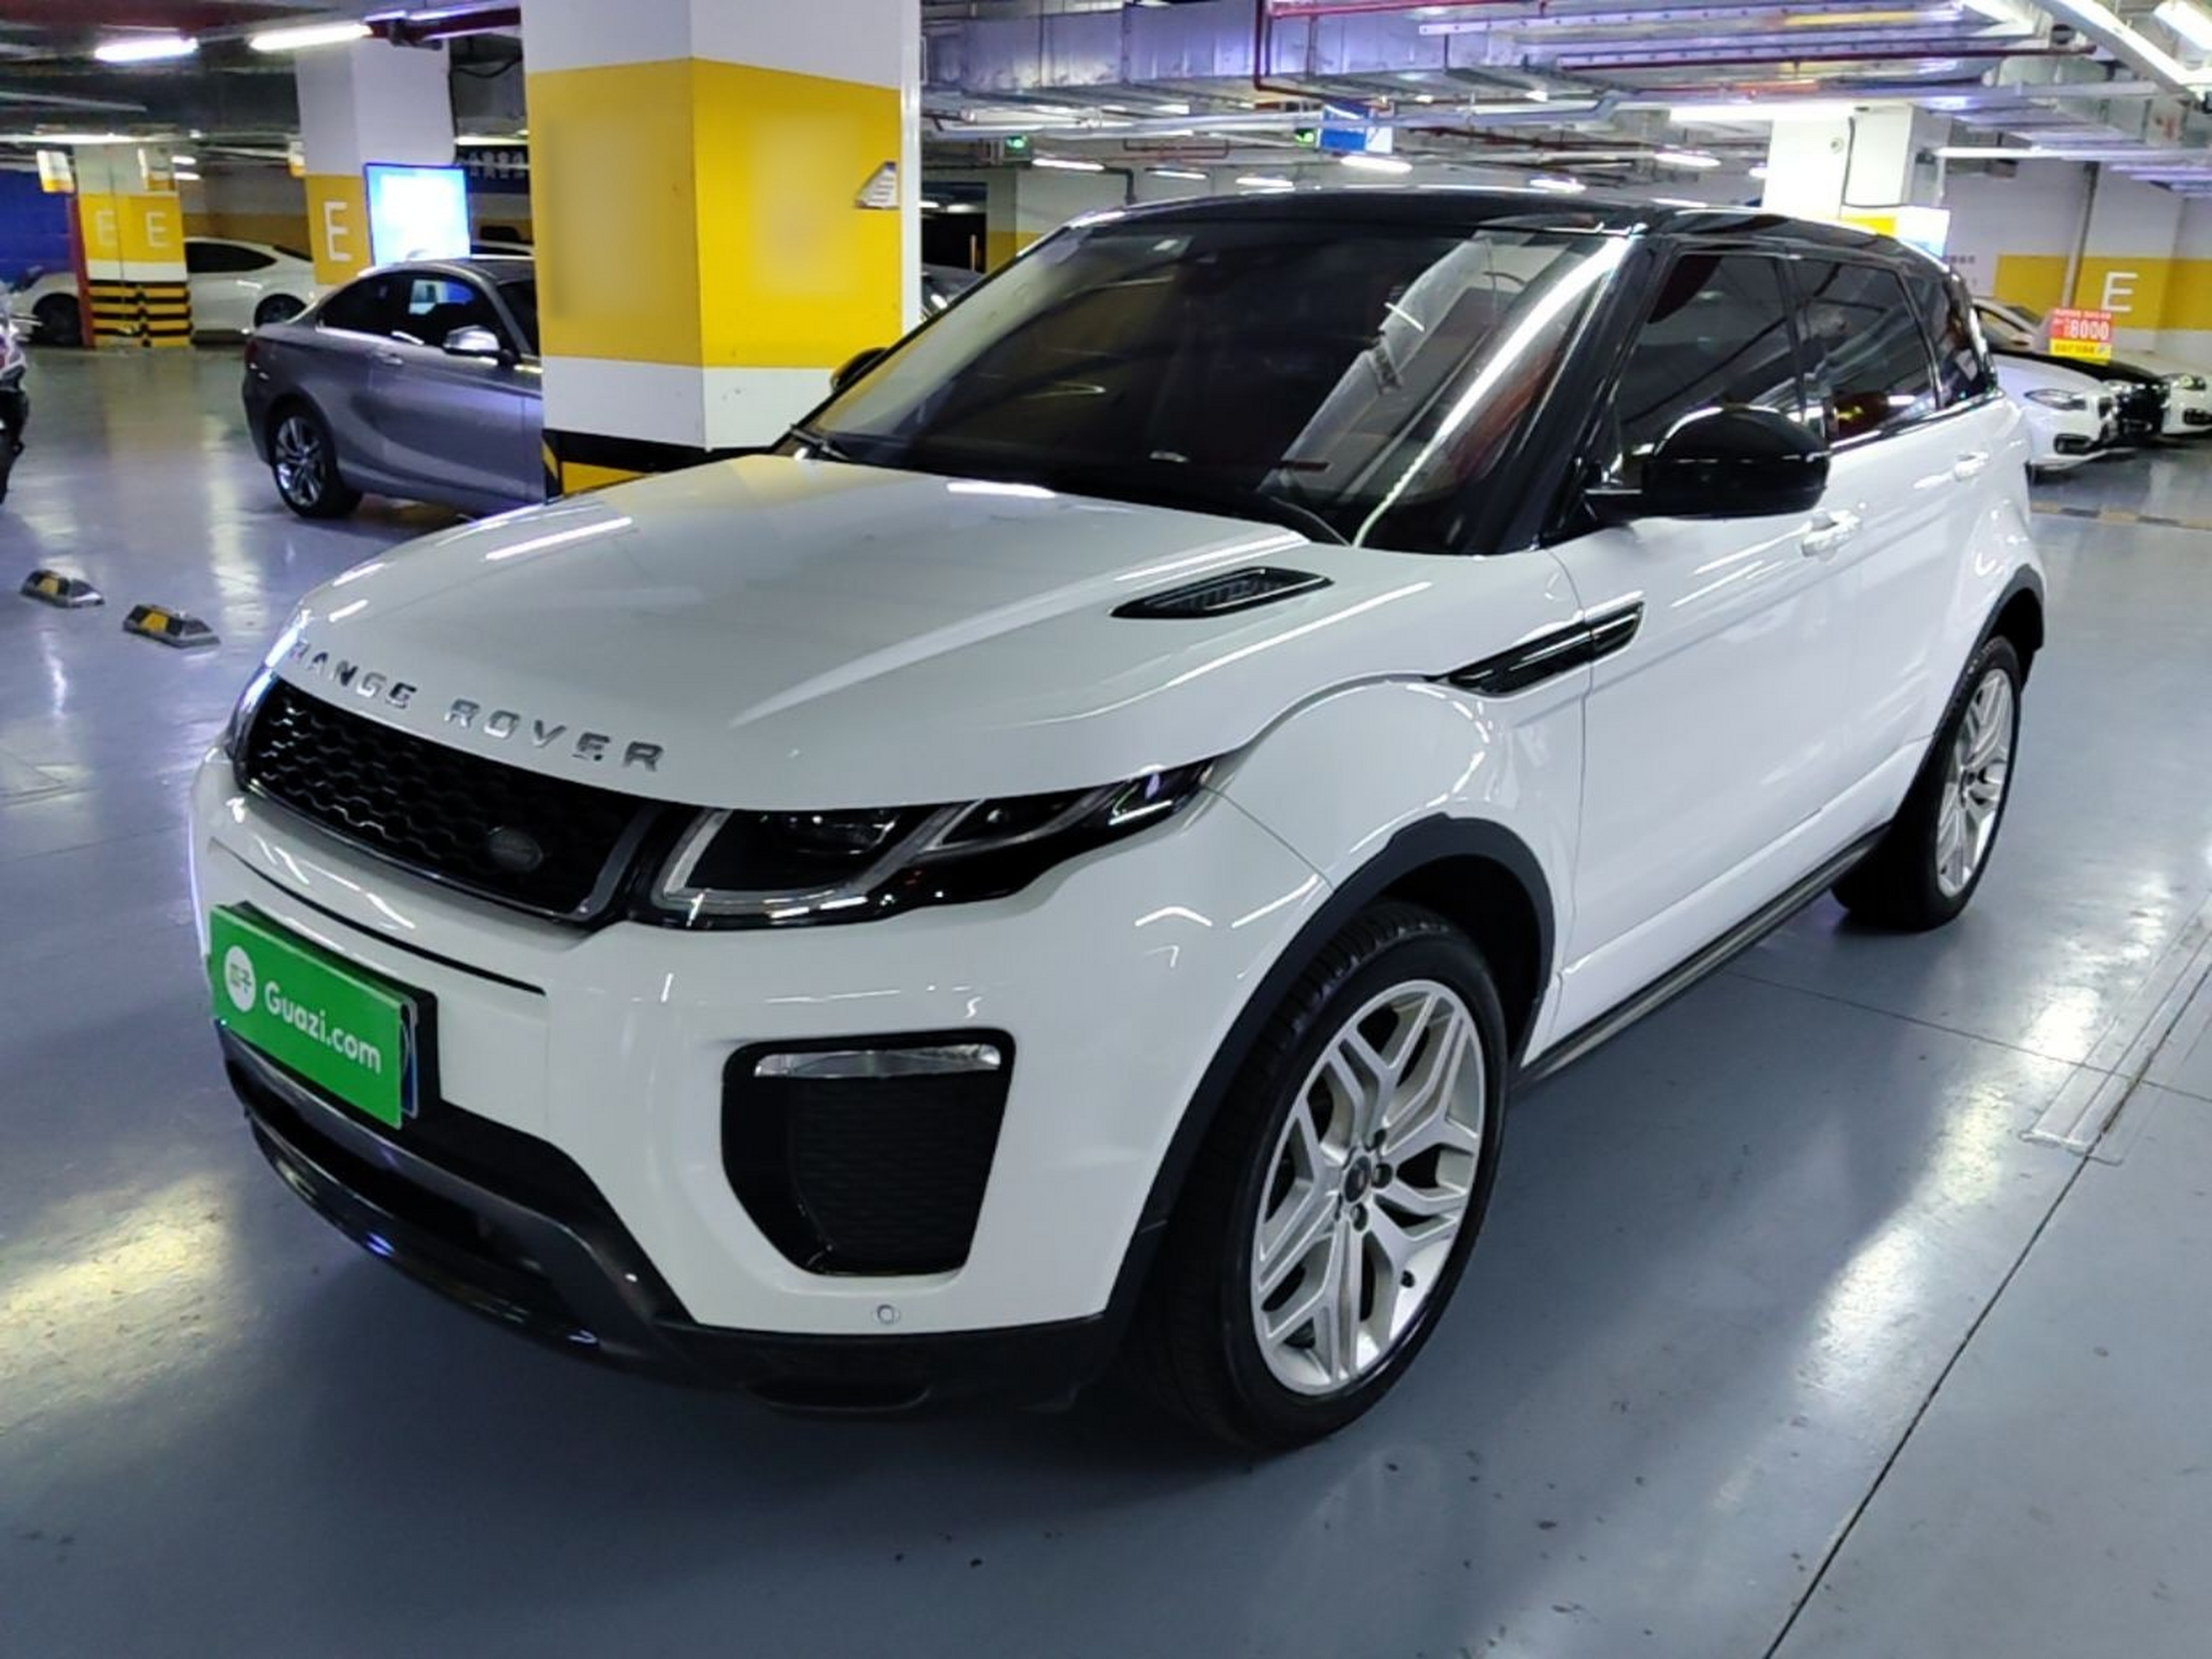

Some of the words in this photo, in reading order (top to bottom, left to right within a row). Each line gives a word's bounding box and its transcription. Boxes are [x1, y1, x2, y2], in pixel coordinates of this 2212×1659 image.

[96, 210, 117, 246] E
[146, 211, 169, 248] E
[323, 201, 352, 262] E
[2102, 271, 2138, 312] E
[289, 639, 417, 709] RANGE
[445, 698, 665, 772] ROVER
[264, 980, 381, 1075] Guazi.com
